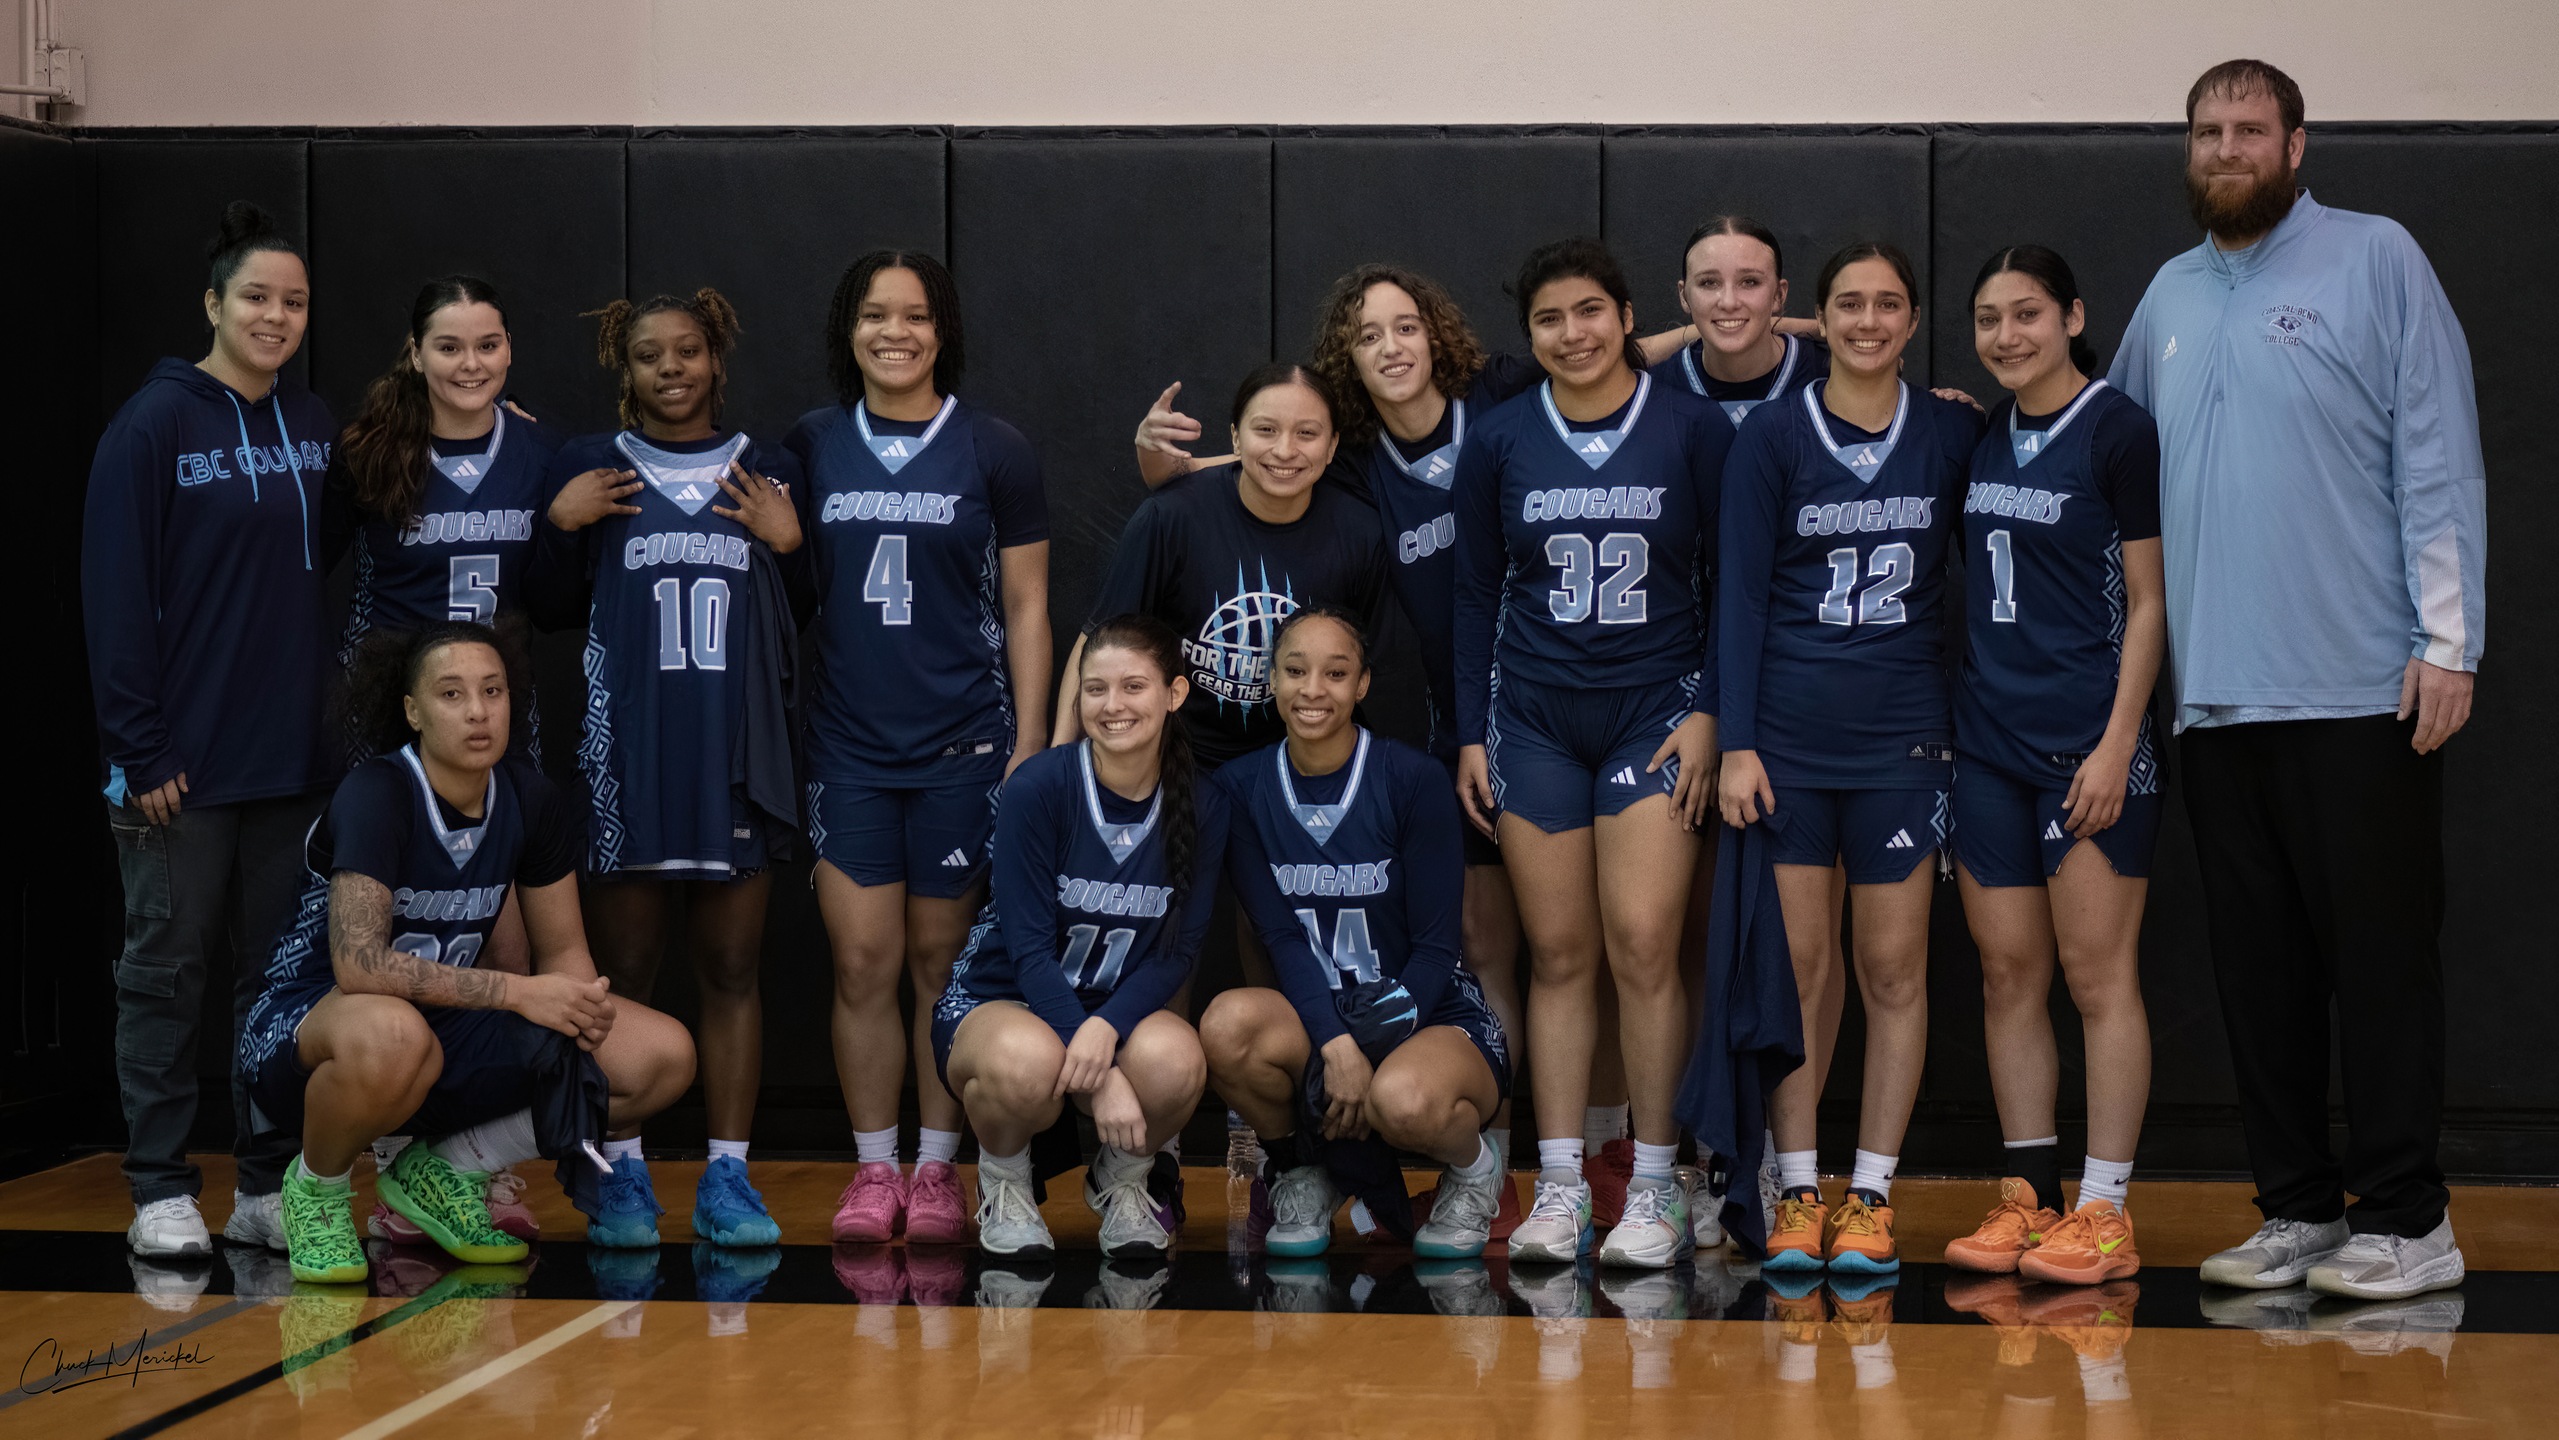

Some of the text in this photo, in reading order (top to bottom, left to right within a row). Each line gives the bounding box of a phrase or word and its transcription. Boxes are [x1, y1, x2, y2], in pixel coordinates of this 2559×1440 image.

[2261, 304, 2318, 324] COASTAL BEND
[2264, 335, 2300, 346] COLLEGE
[177, 449, 232, 487] CBC
[821, 491, 962, 525] COUGARS
[1523, 486, 1667, 523] COUGARS
[1797, 496, 1936, 537] COUGARS
[1399, 511, 1456, 565] COU
[449, 554, 500, 630] 5
[864, 534, 912, 625] 4
[1544, 532, 1649, 624] 32
[1819, 542, 1914, 626] 12
[1987, 529, 2016, 623] 1
[654, 577, 731, 671] 10
[1181, 638, 1269, 680] FOR THE
[1198, 673, 1233, 698] FEAR
[1237, 684, 1263, 700] THE
[1269, 858, 1392, 897] OUGARS
[1061, 924, 1137, 993] 11
[1294, 908, 1382, 990] 14
